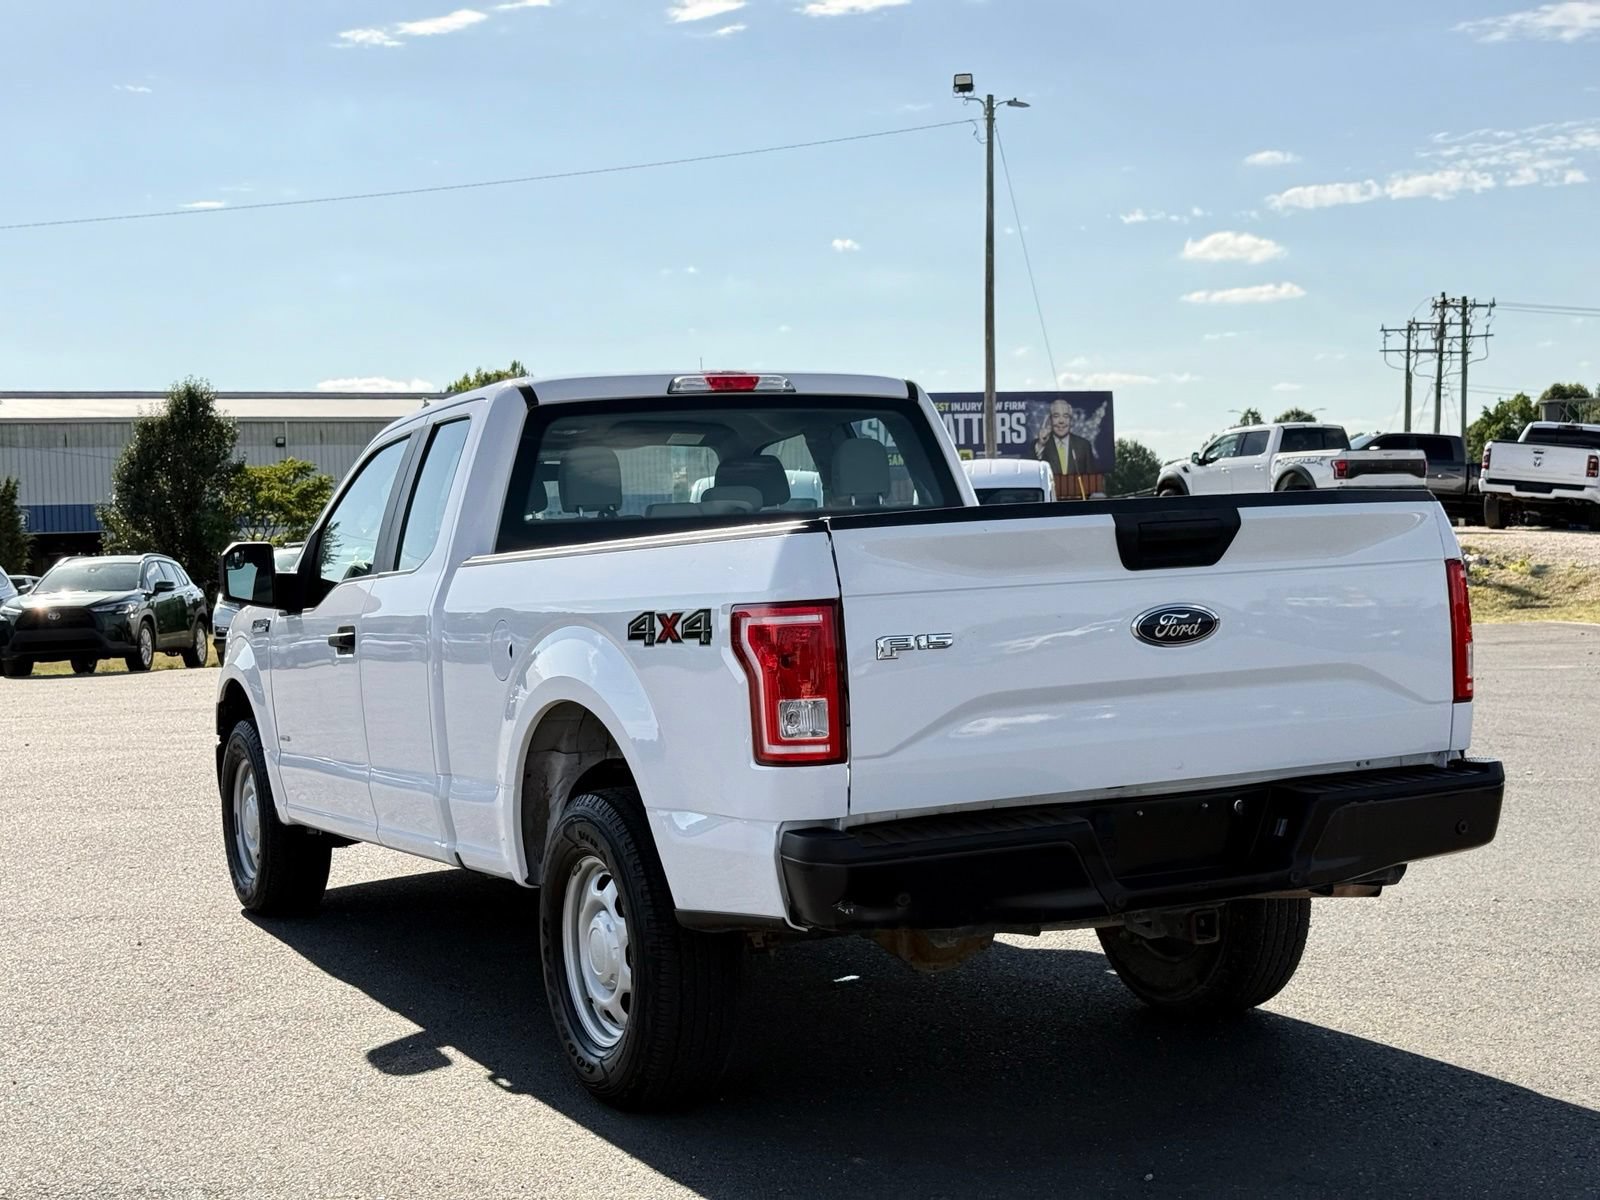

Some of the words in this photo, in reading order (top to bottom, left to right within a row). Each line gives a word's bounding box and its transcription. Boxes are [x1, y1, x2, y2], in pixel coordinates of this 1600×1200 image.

[951, 402, 982, 411] INJURY
[1004, 401, 1026, 410] FIRM
[942, 412, 1027, 445] ATTRS
[1155, 613, 1201, 638] Ford
